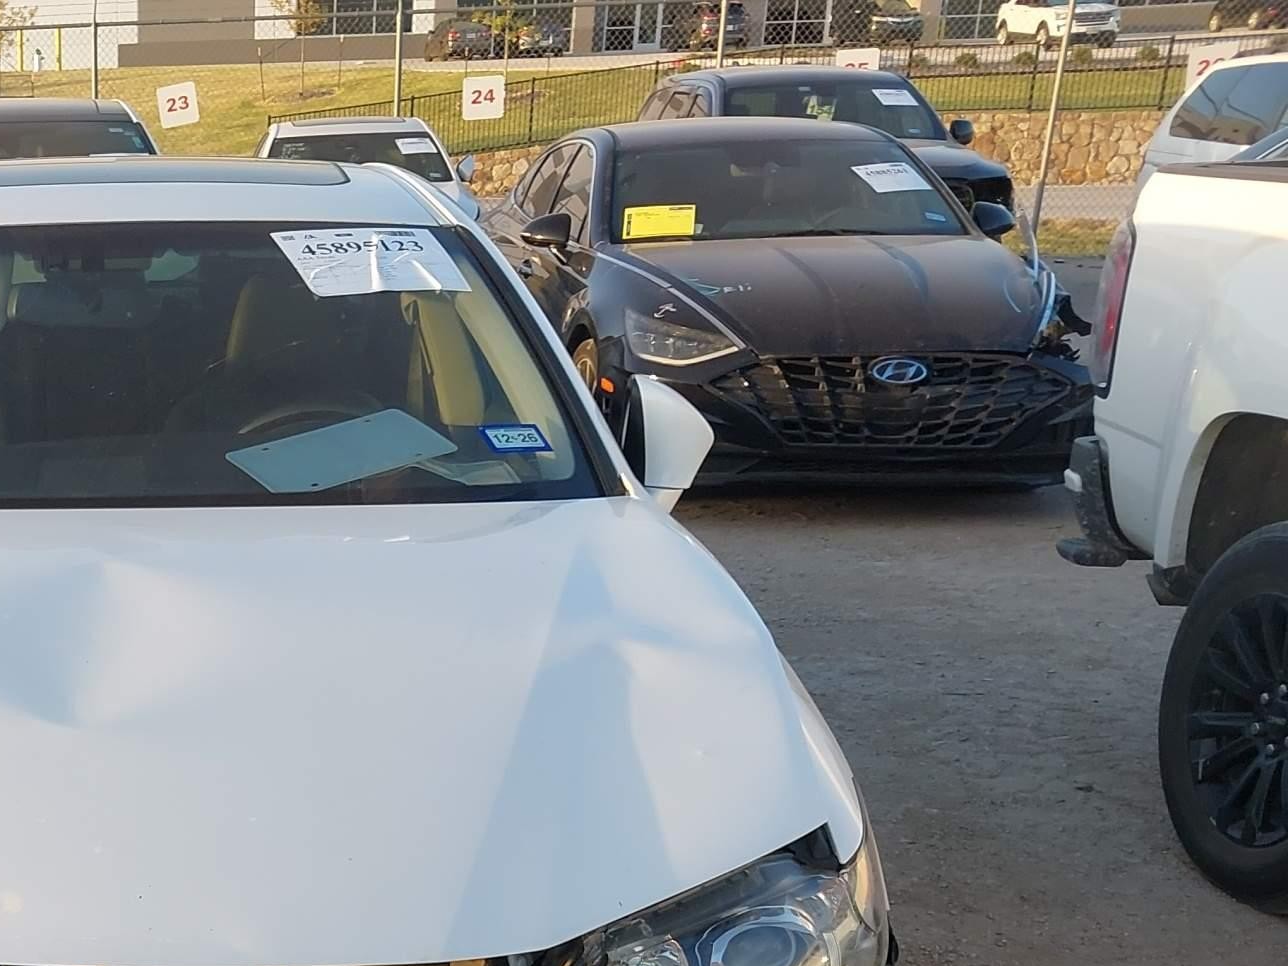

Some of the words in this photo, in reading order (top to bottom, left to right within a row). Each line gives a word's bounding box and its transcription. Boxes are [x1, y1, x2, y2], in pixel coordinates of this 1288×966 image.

[1196, 57, 1225, 77] 2
[166, 95, 189, 113] 23
[471, 88, 496, 105] 24
[301, 239, 424, 256] 45895123
